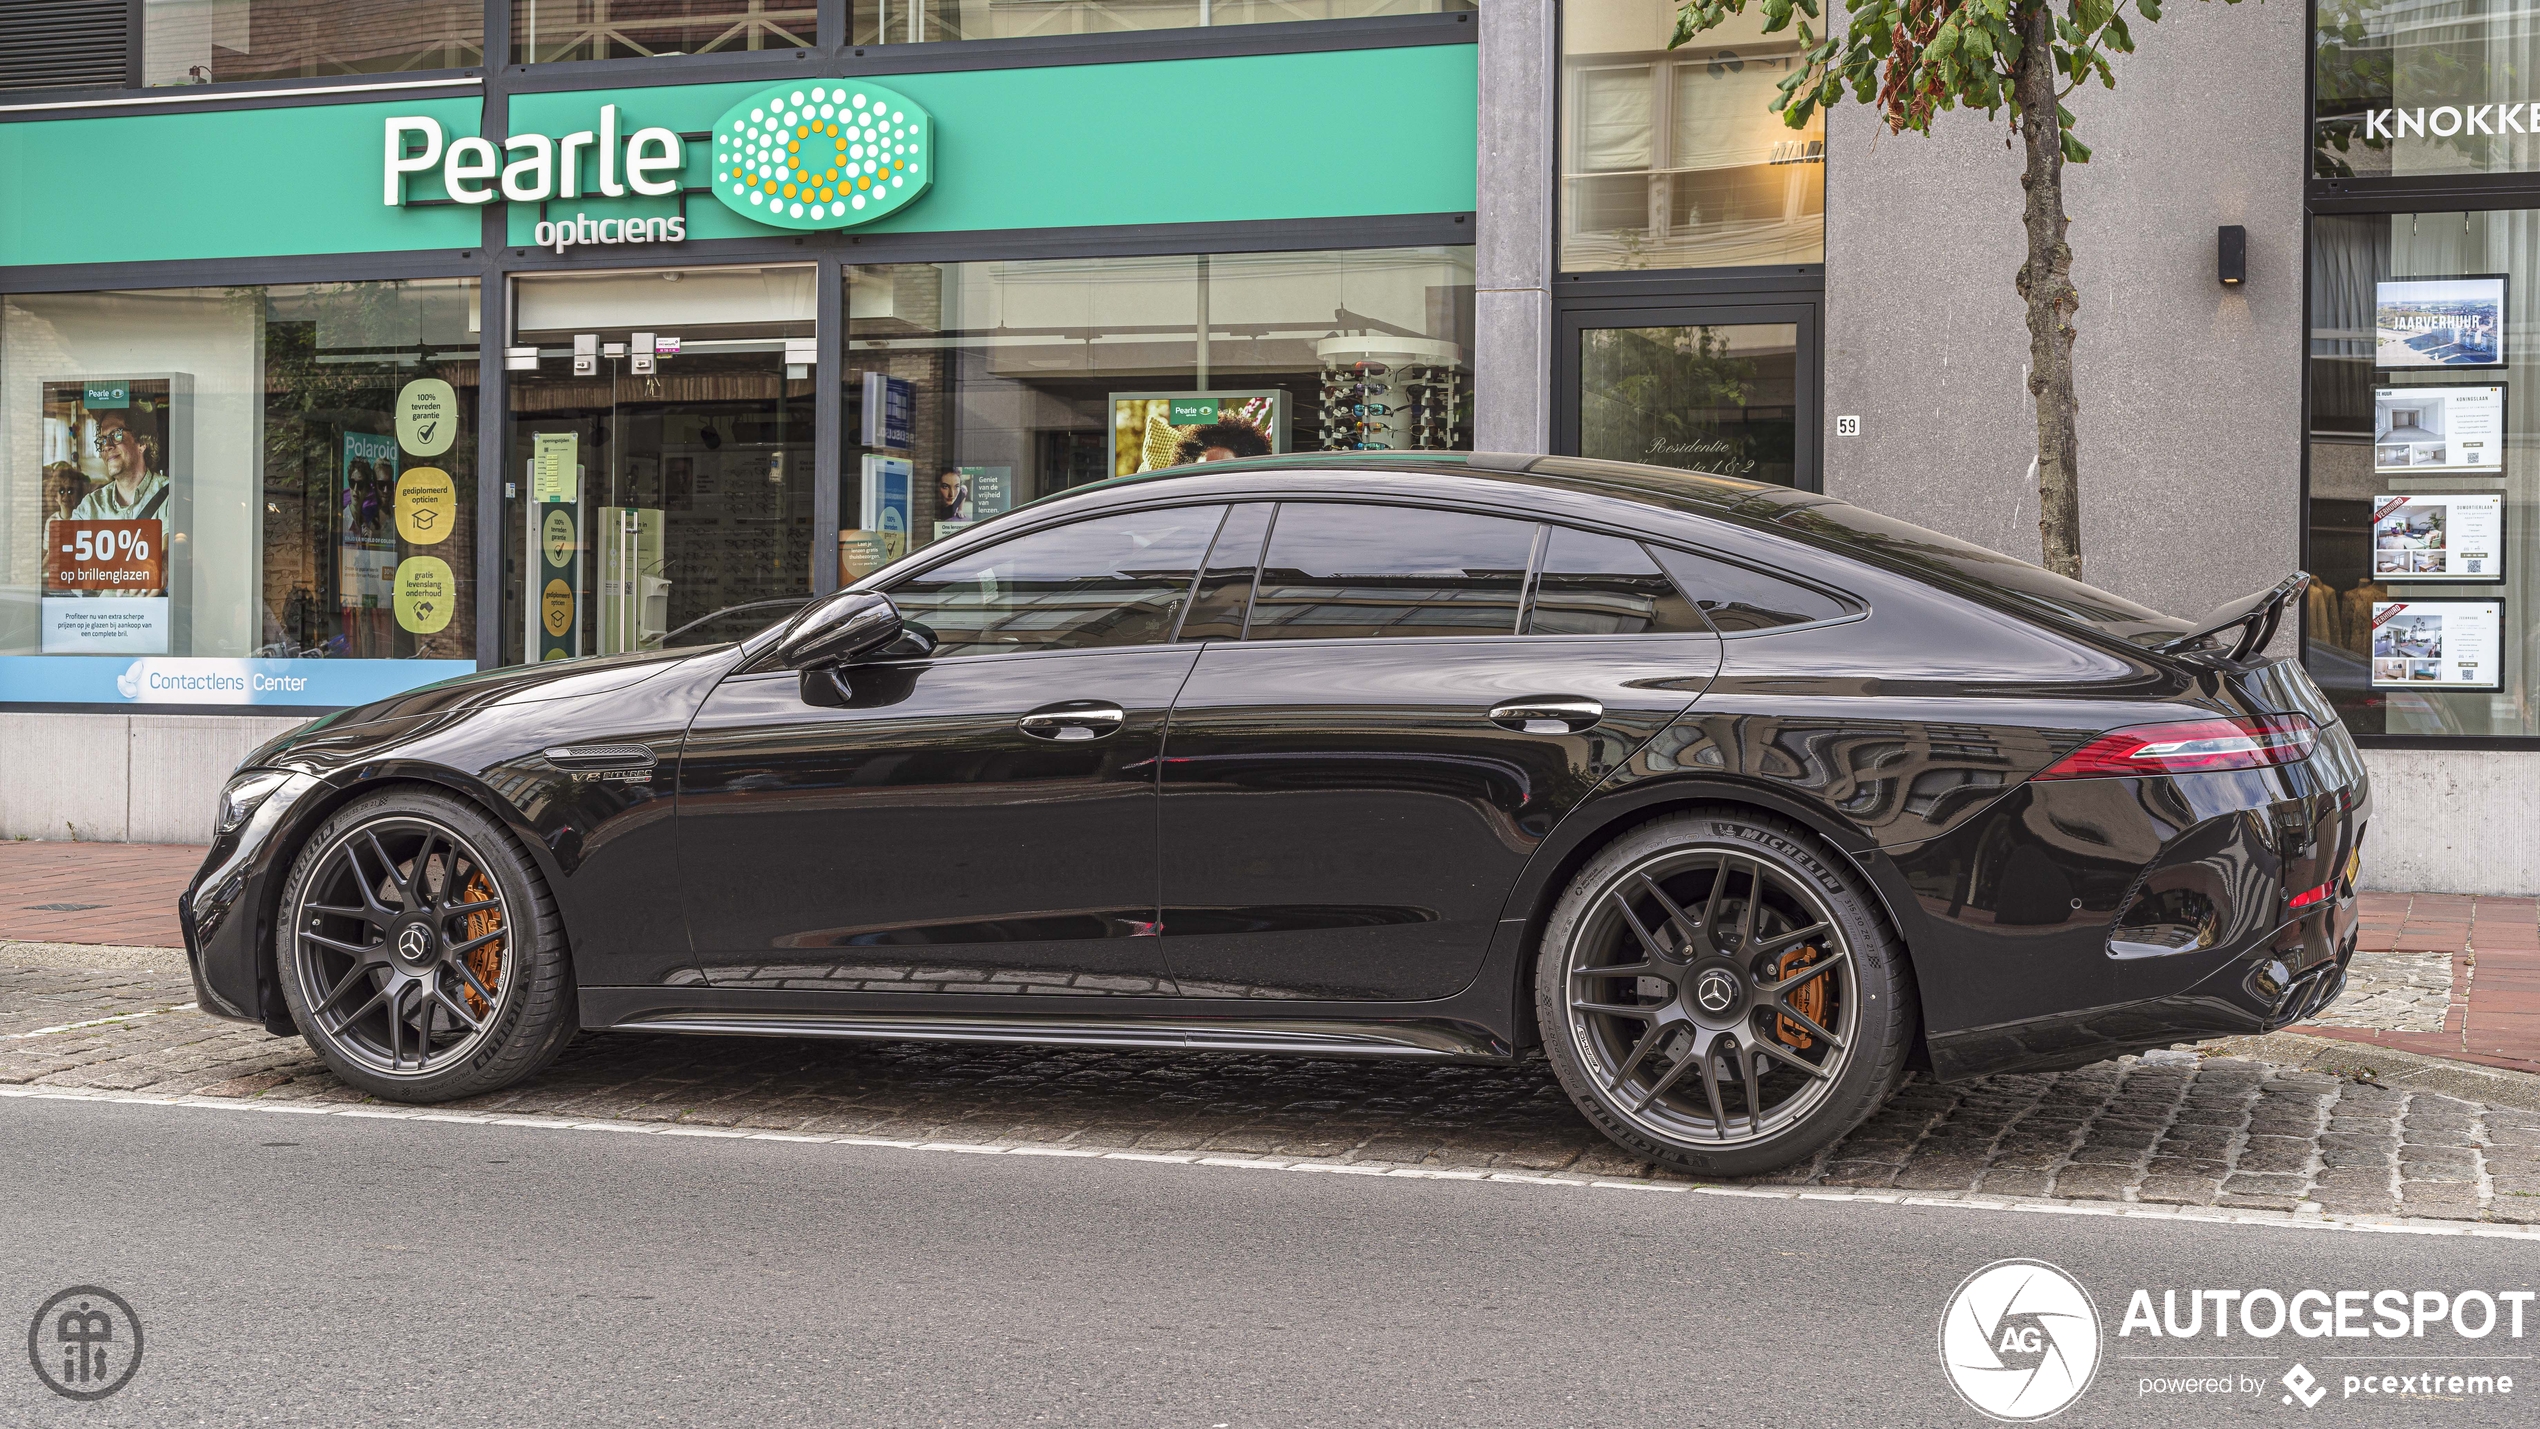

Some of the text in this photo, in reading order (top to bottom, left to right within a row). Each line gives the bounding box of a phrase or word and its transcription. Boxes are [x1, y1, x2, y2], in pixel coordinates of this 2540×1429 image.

[383, 104, 684, 207] Pearle
[534, 212, 686, 254] opticiens
[2393, 314, 2480, 330] JAARVERHUUR
[89, 389, 109, 398] Pearle
[417, 393, 436, 401] 100%
[412, 412, 440, 421] garantie
[1175, 406, 1197, 414] Pearle
[1840, 419, 1855, 433] 59
[346, 436, 398, 461] Polaroid
[1645, 437, 1730, 454] Residentie
[1723, 456, 1740, 476] &
[1740, 460, 1755, 473] 2
[402, 486, 448, 497] gediplomeerd
[978, 492, 1001, 500] vrijheid
[411, 495, 438, 505] opticien
[2376, 497, 2404, 519] VERHUURD
[62, 528, 149, 562] -50%
[551, 534, 566, 542] garantie
[61, 568, 150, 584] op brillenglazen
[415, 571, 434, 580] gratis
[406, 580, 442, 590] levenslang
[405, 589, 442, 597] onderhoud
[546, 591, 571, 600] gediplomeerd
[123, 613, 144, 621] scherpe
[2373, 604, 2401, 626] VERHUURD
[57, 622, 76, 630] prijzen
[85, 622, 90, 630] je
[91, 622, 109, 630] glazen
[117, 622, 141, 630] aankoop
[92, 630, 117, 638] complete
[150, 673, 307, 691] Contactlens Center
[571, 772, 600, 783] V8
[286, 825, 332, 903] MICHELIN
[1740, 827, 1841, 890] MICHELIN
[1844, 898, 1875, 952] 315/30 ZR 21
[1548, 1024, 1564, 1059] SPORT
[1561, 1062, 1580, 1089] PILOT
[1585, 1099, 1680, 1162] MICHELIN
